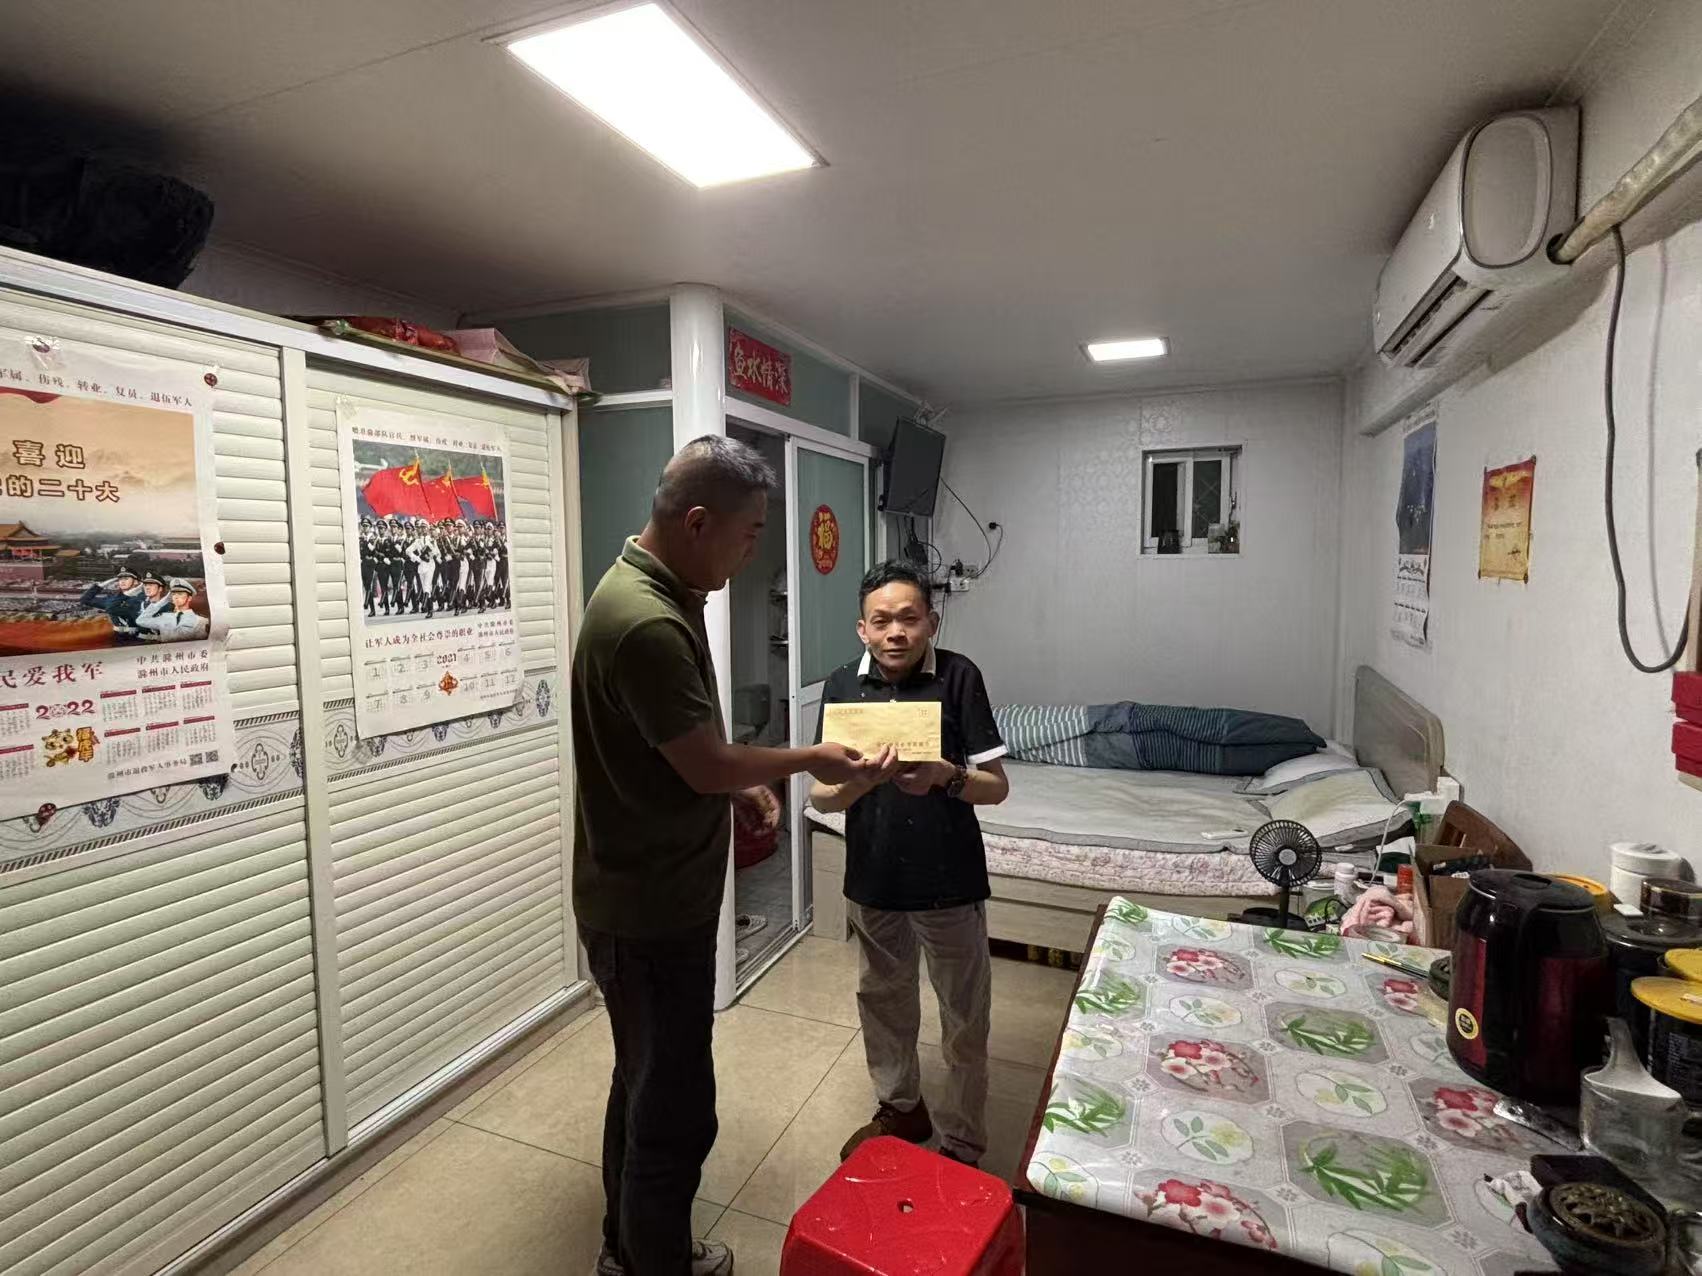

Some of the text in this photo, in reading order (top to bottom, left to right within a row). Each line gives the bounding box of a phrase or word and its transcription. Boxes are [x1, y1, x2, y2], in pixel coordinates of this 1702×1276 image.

[733, 341, 789, 395] 鱼水情深
[12, 439, 86, 469] 喜迎
[0, 475, 120, 503] 的二十大
[365, 626, 474, 649] 让军人成为全社会尊崇的职业
[136, 649, 208, 666] 中共滁州市委
[0, 661, 103, 689] 民爱我军
[137, 662, 209, 679] 滁州市人民政府
[36, 699, 96, 721] 2022
